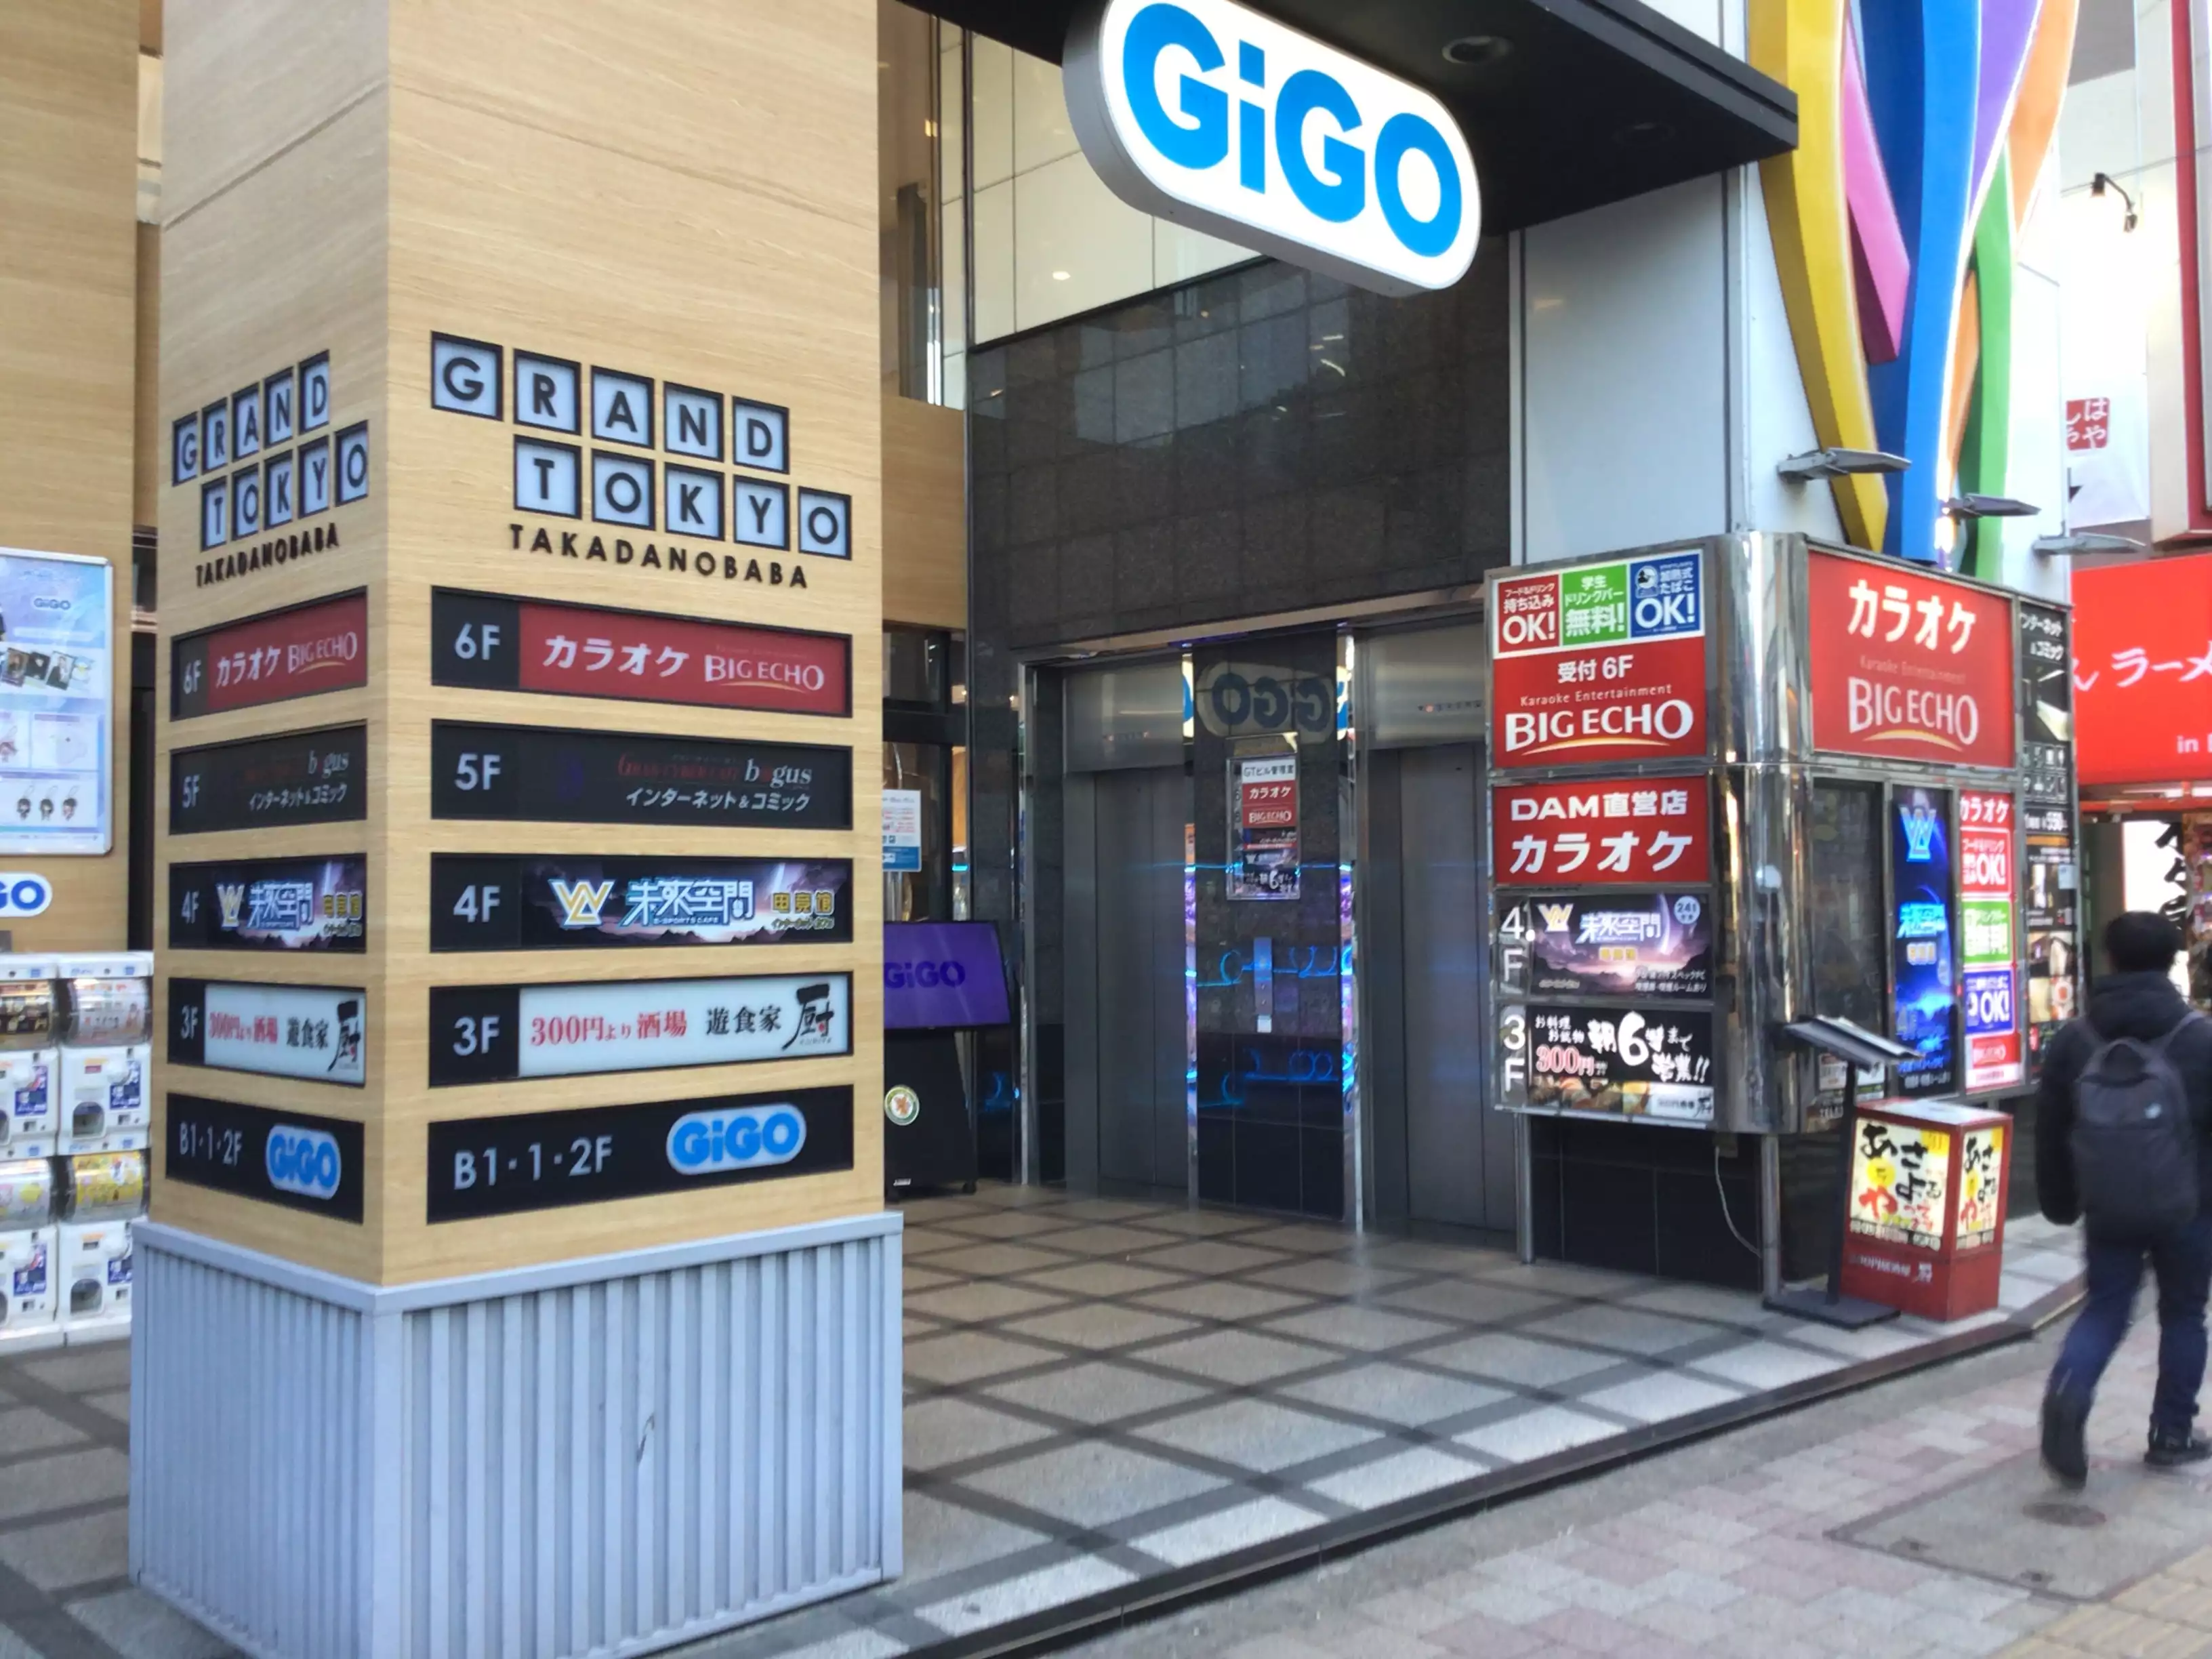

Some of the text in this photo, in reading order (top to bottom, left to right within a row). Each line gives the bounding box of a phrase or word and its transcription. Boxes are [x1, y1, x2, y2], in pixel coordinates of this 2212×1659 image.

[1123, 2, 1462, 258] GiGO
[182, 374, 327, 472] GRAND
[443, 356, 773, 457] GRAND
[213, 443, 367, 535] TOKYO
[533, 458, 839, 545] TOKYO
[196, 523, 339, 588] TAKADANOBABA
[510, 524, 807, 589] TAKADANOBABA
[1564, 588, 1624, 607] ドリンクバー
[1581, 575, 1607, 591] 学生
[34, 597, 71, 610] GiGO
[1504, 594, 1555, 614] 持ち込み
[1565, 602, 1624, 637] 無料!
[1635, 592, 1695, 629] OK!
[1847, 579, 1977, 654] カラオケ
[1502, 611, 1555, 644] OK!
[183, 632, 358, 694] 6F カラオケ BIG ECHO
[454, 623, 500, 661] 6F
[542, 634, 690, 677] カラオケ
[704, 654, 752, 682] BIG
[758, 661, 825, 691] ECHO
[1557, 654, 1635, 684] 受付 6F
[1521, 684, 1673, 707] Karaoke Entertainment
[1848, 676, 1978, 745] BIG ECHO
[1505, 699, 1694, 752] BIG ECHO
[182, 774, 200, 808] 5F
[454, 753, 501, 790] 5F
[626, 786, 811, 813] インターネット&コミック
[1249, 786, 1292, 800] カラオケ
[1511, 790, 1688, 821] DAM直営店
[1509, 830, 1693, 874] カラオケ
[181, 890, 199, 924] 4F
[453, 885, 500, 922] 4F
[1500, 906, 1525, 983] 4F
[884, 960, 966, 989] GiGO
[180, 1005, 199, 1040] 3F
[453, 1017, 499, 1057] 3F
[531, 1009, 687, 1046] 300円より酒場
[705, 1005, 782, 1036] 遊食家
[1502, 1014, 1526, 1092] 3F
[672, 1111, 800, 1167] GiGO
[268, 1132, 338, 1191] GiGO
